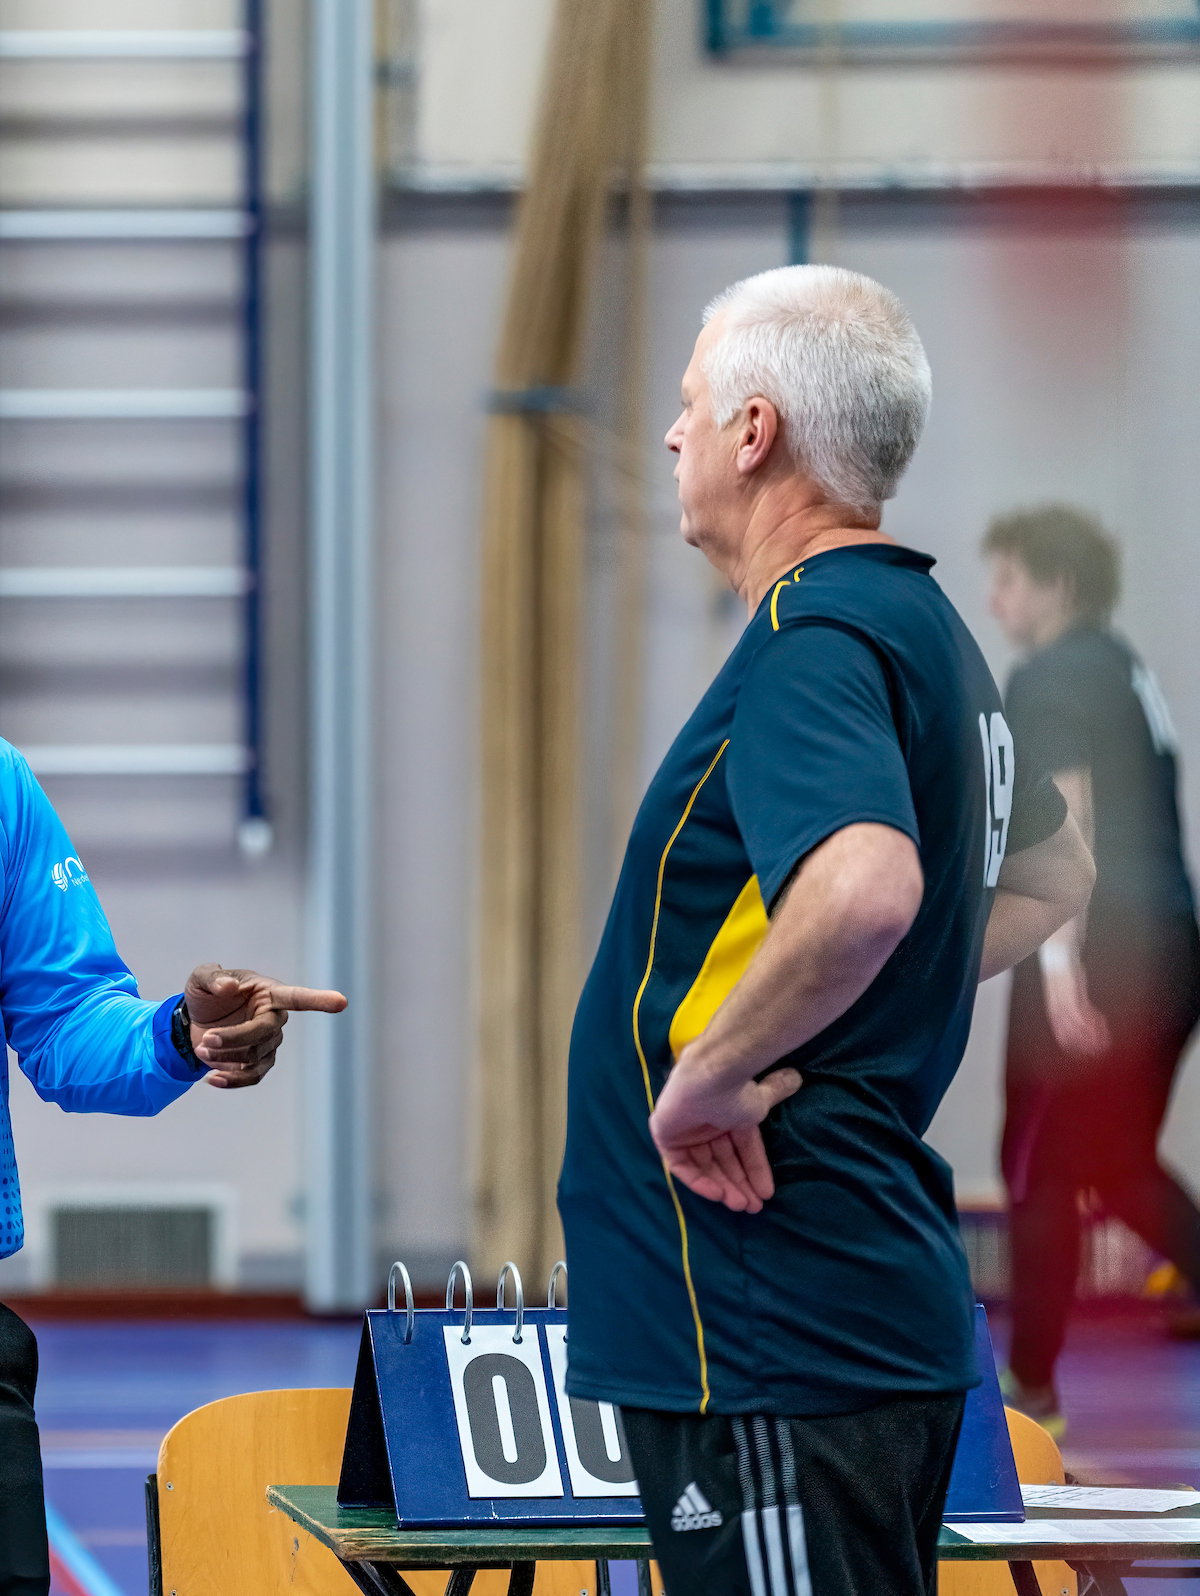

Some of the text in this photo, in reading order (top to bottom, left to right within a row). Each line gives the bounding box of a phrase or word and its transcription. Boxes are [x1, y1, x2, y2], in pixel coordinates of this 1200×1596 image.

[978, 711, 1016, 888] 19
[463, 1353, 547, 1485] 0
[670, 1510, 723, 1531] adidas
